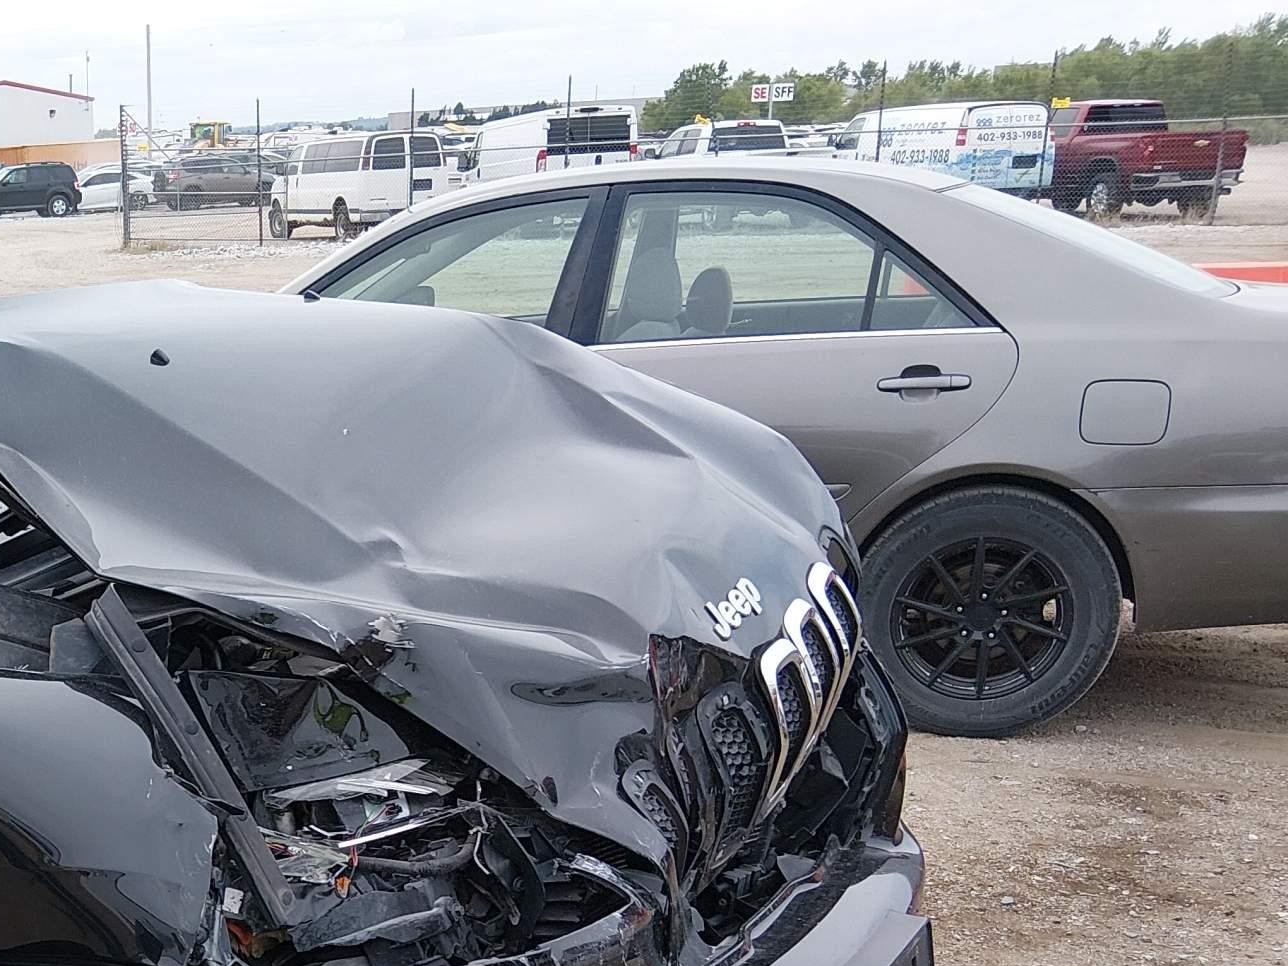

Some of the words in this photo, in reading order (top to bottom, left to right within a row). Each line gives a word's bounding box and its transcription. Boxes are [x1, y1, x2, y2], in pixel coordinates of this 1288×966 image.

[753, 87, 767, 99] SE
[774, 86, 793, 98] SFF
[996, 113, 1042, 124] zerorez
[976, 131, 1043, 142] 402-933-1988
[890, 149, 951, 165] 402-933-1988
[704, 577, 762, 641] Jeep
